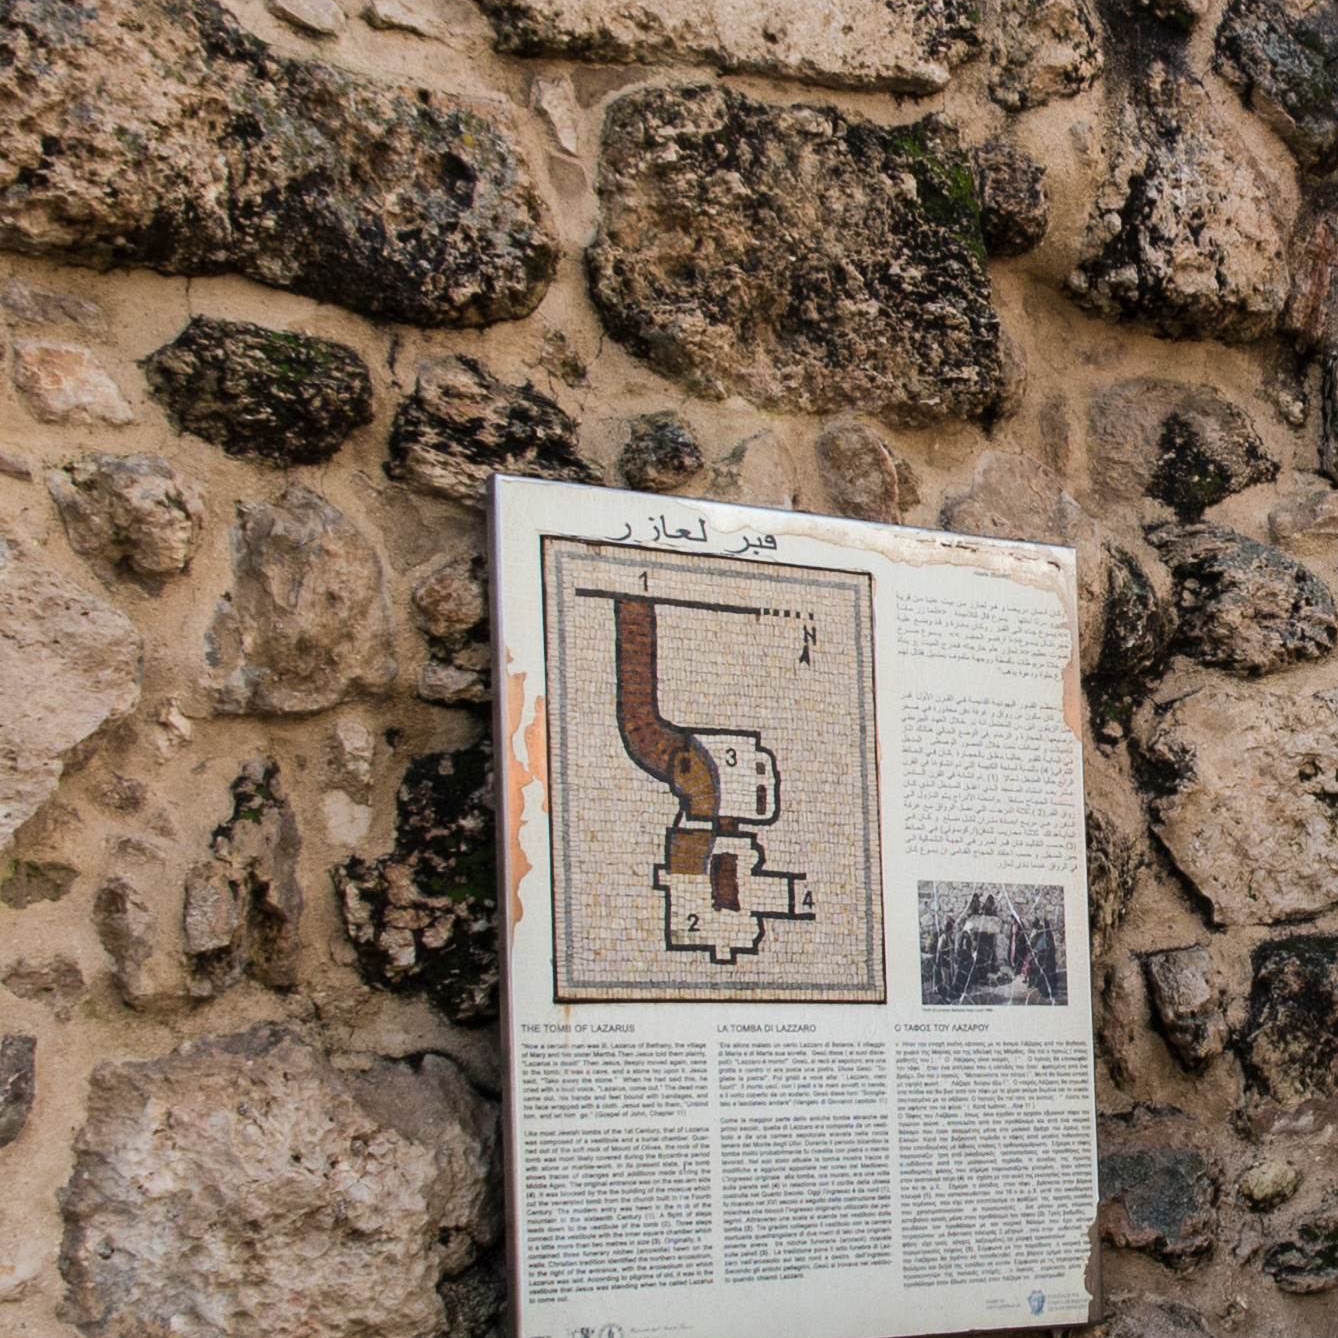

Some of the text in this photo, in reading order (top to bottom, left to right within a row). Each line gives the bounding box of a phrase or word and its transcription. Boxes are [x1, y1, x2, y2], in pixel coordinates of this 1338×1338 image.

[639, 571, 649, 592] 1
[803, 624, 816, 645] N
[725, 747, 738, 767] 3
[802, 890, 815, 909] 4
[687, 913, 700, 932] 2
[544, 1025, 571, 1033] TOMB
[575, 1025, 587, 1033] OF
[591, 1025, 635, 1033] LAZARUS
